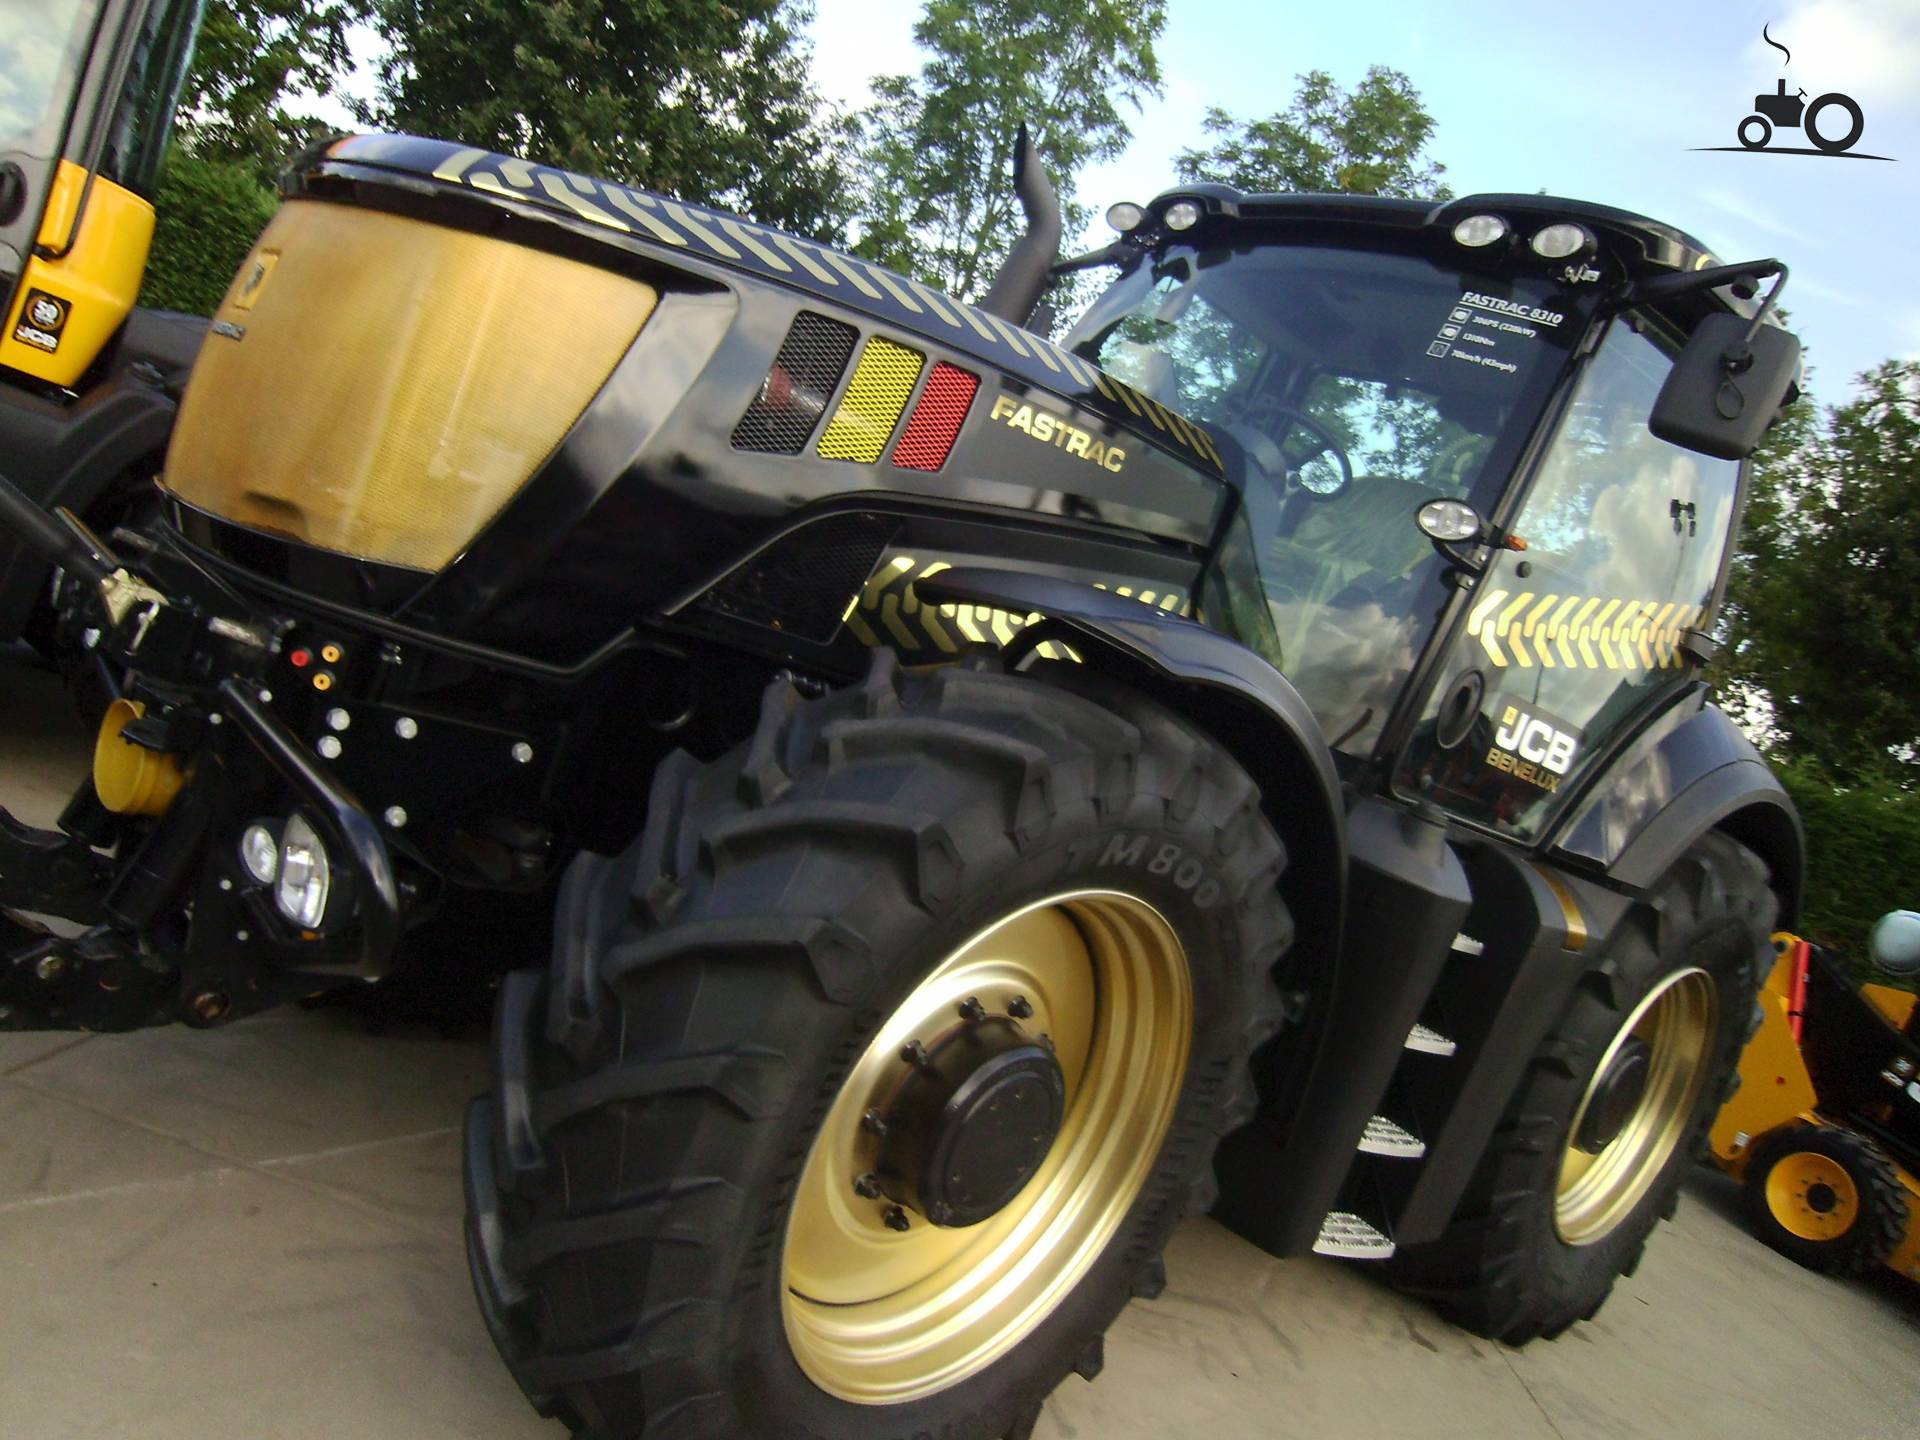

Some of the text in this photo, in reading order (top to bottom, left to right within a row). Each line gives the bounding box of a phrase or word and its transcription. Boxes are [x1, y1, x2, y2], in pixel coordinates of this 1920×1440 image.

[1461, 291, 1563, 324] FASTRAC 8310
[16, 326, 58, 349] JCB
[990, 394, 1126, 473] FASTRAC
[1495, 712, 1577, 775] JCB
[1485, 747, 1561, 794] BENELUX
